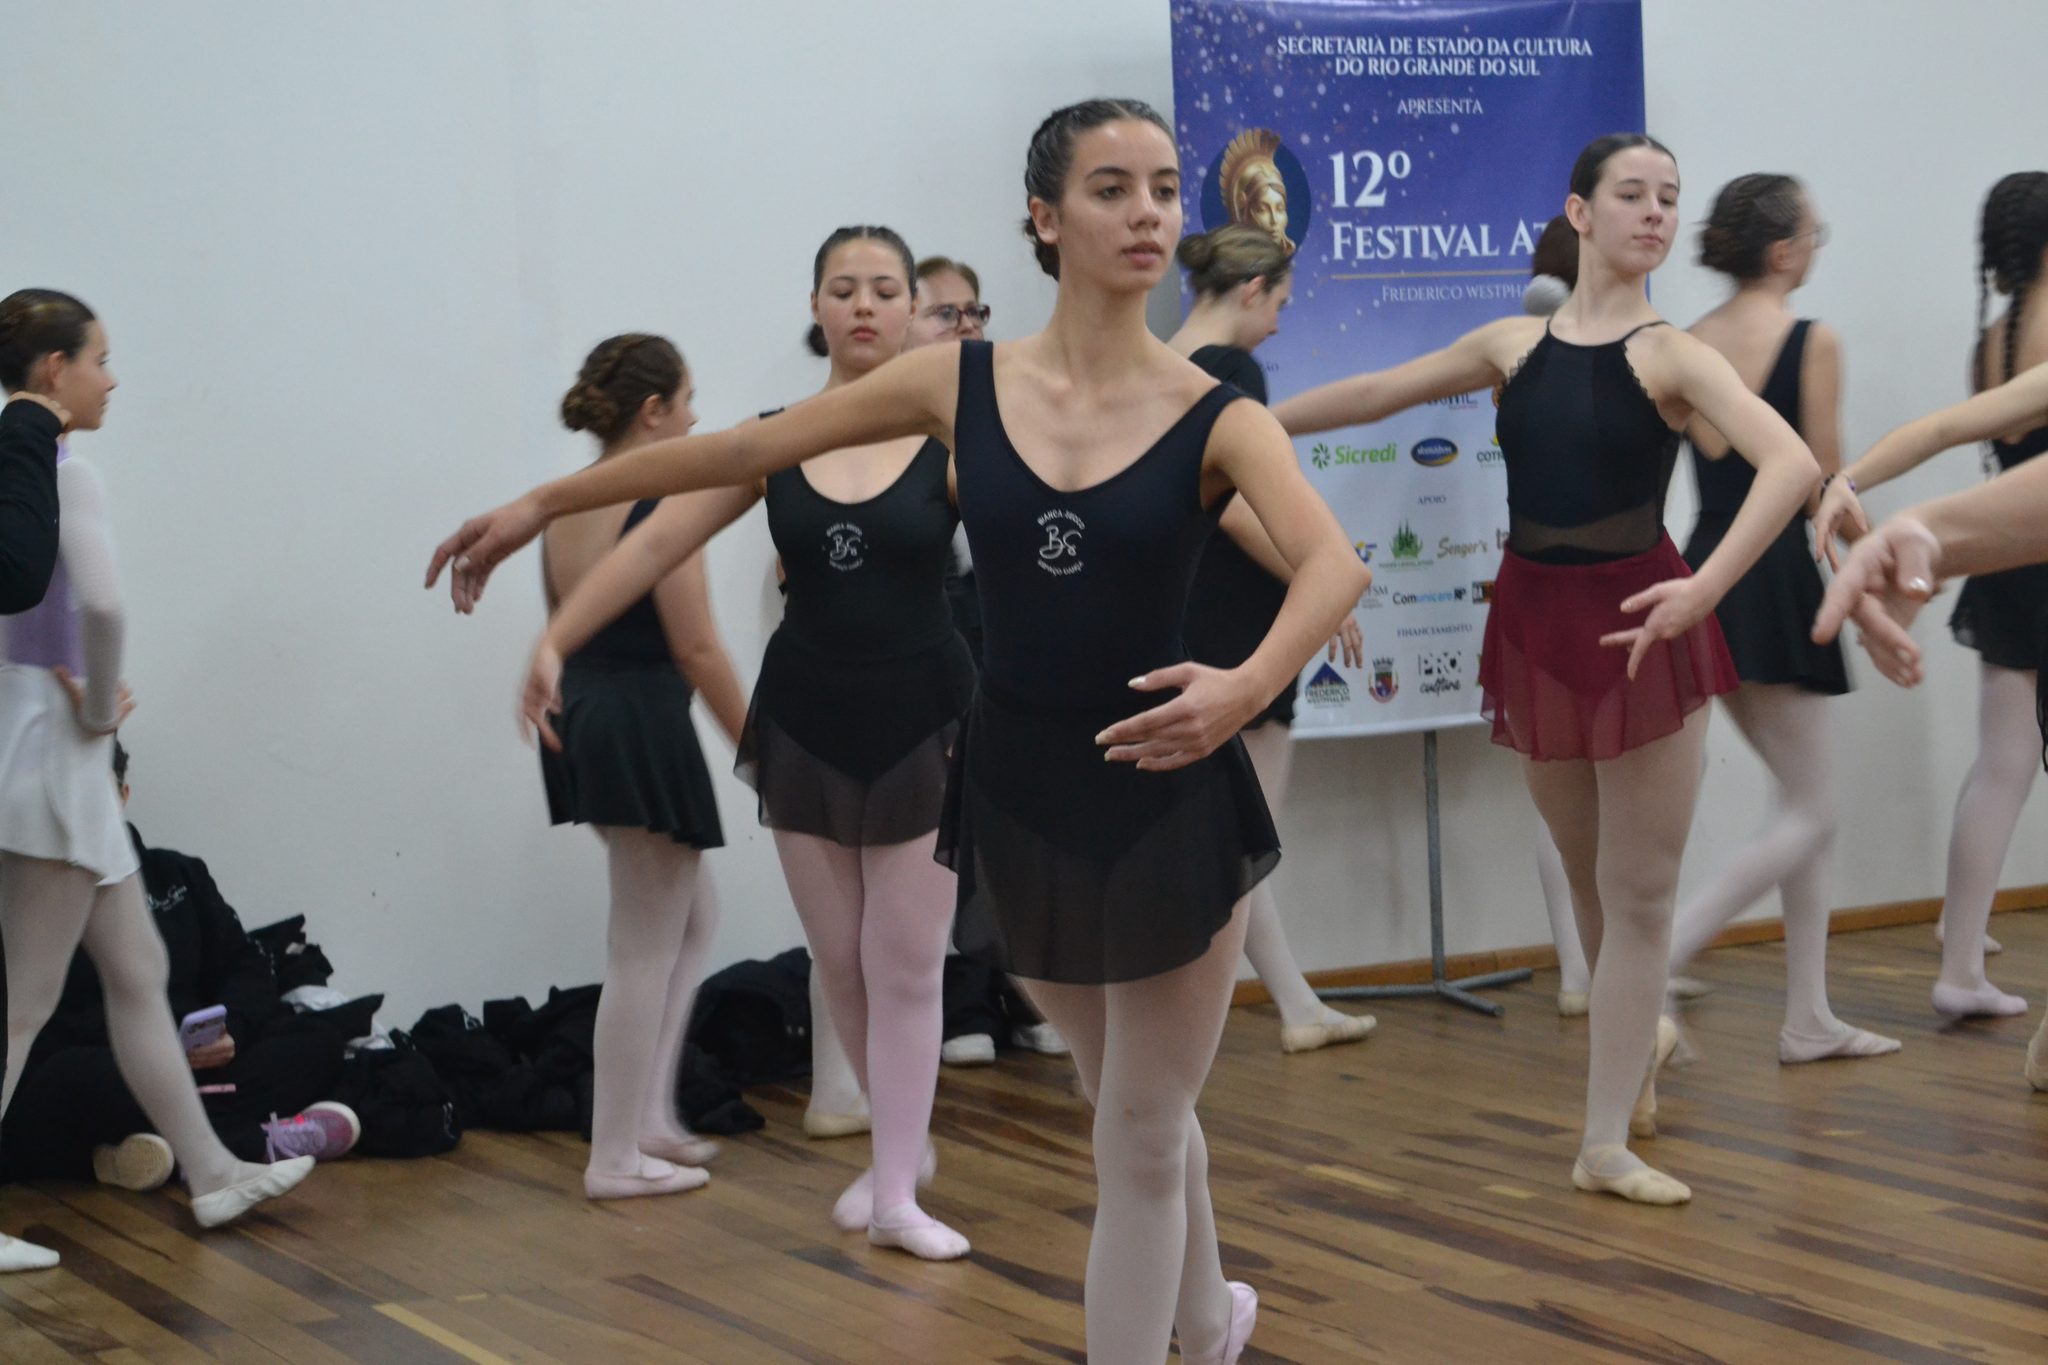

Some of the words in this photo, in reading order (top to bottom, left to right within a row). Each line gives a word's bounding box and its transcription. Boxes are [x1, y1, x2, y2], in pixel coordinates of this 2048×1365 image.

[1277, 35, 1386, 55] SECRETARIA
[1389, 36, 1413, 55] DE
[1417, 36, 1484, 56] ESTADO
[1487, 37, 1511, 56] DA
[1513, 37, 1593, 56] CULTURA
[1335, 57, 1364, 76] DO
[1367, 57, 1400, 76] RIO
[1403, 57, 1476, 76] GRANDE
[1479, 57, 1506, 76] DO
[1509, 58, 1540, 76] SUL
[1397, 98, 1484, 115] APRESENTA
[1331, 221, 1500, 260] FESTIVAL
[1381, 285, 1463, 301] FREDERICO
[1334, 442, 1397, 465] Sicredi
[1418, 495, 1446, 505] APOIO
[1437, 537, 1488, 559] Senger's
[1397, 623, 1473, 637] FINANCIAMENTO
